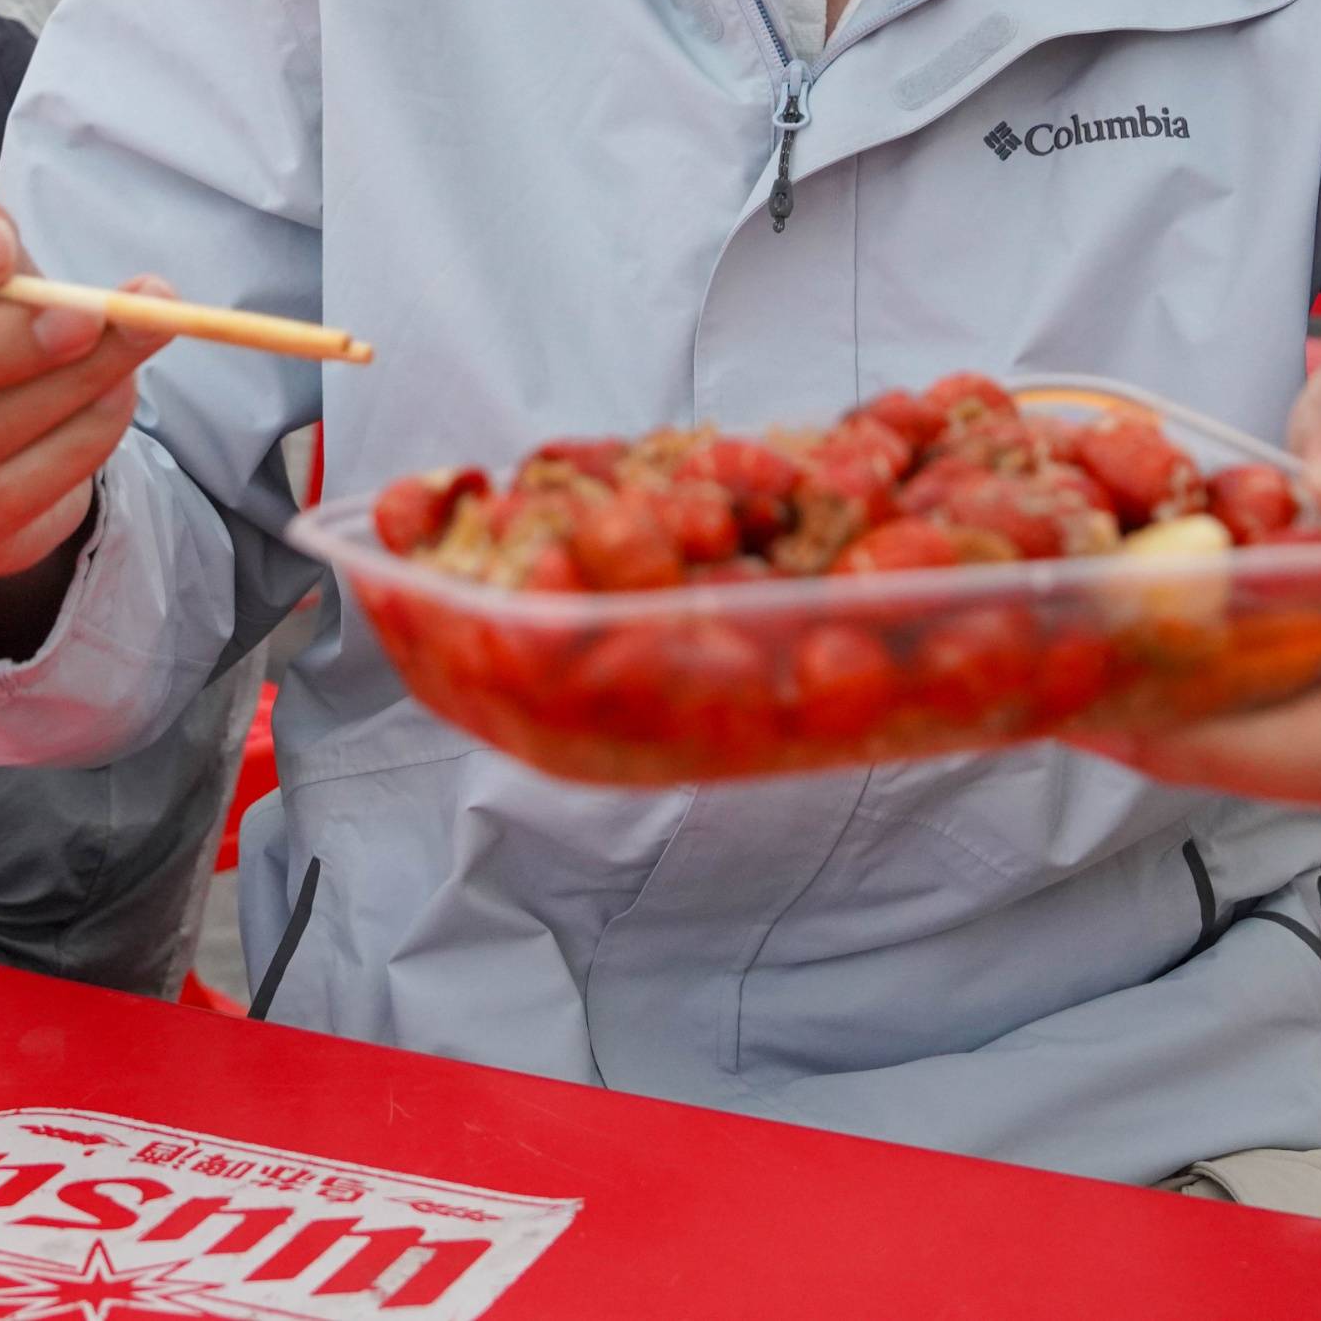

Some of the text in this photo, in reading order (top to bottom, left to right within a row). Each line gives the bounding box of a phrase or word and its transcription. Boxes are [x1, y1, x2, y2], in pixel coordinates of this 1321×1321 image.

[1024, 104, 1191, 157] Columbia
[129, 1141, 374, 1204] 乌苏啤酒
